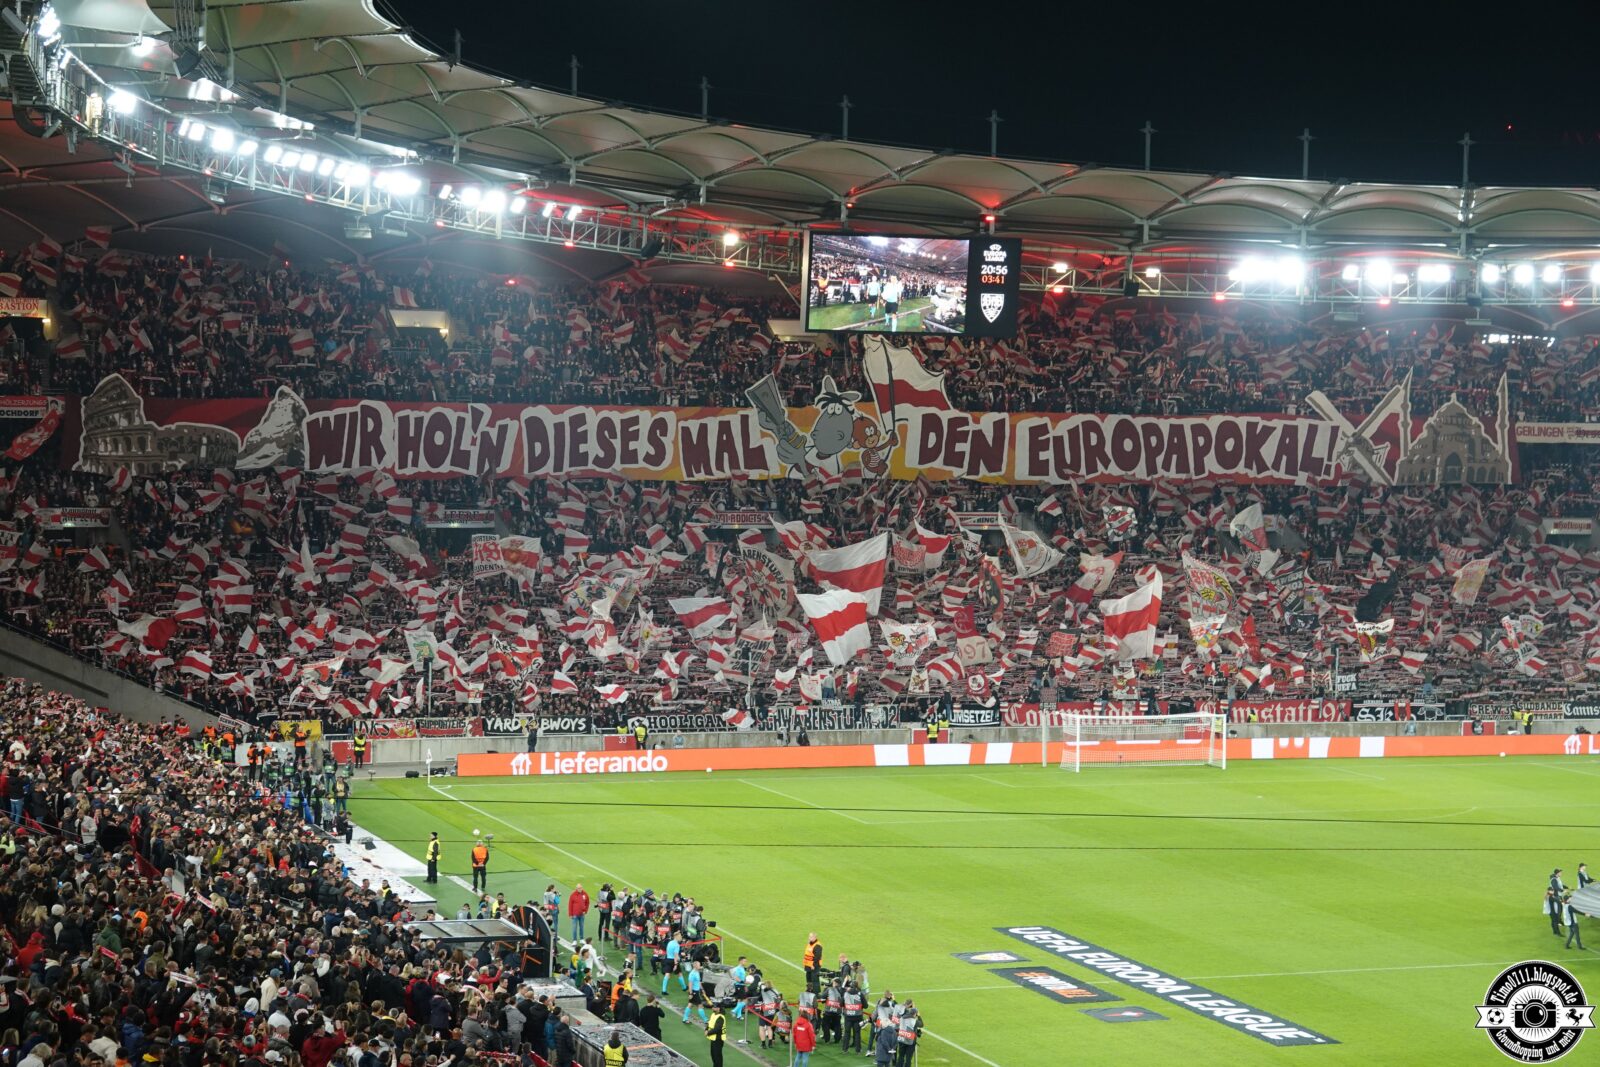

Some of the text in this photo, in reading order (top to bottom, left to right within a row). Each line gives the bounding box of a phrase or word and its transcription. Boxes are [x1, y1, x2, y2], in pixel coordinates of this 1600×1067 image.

[981, 265, 1008, 275] 20:56
[981, 275, 1005, 284] 03:41
[1516, 426, 1564, 437] GERLINGEN
[306, 403, 1341, 480] WIR HOL'N DIESES MAL DEN EUROPAPOKAL!
[486, 717, 587, 732] YARD BWOYS
[618, 735, 627, 744] 33
[540, 750, 669, 775] Lieferando
[1008, 926, 1090, 953] UEFA
[1074, 952, 1192, 995] EUROPA
[1169, 993, 1315, 1041] LEAGUE
